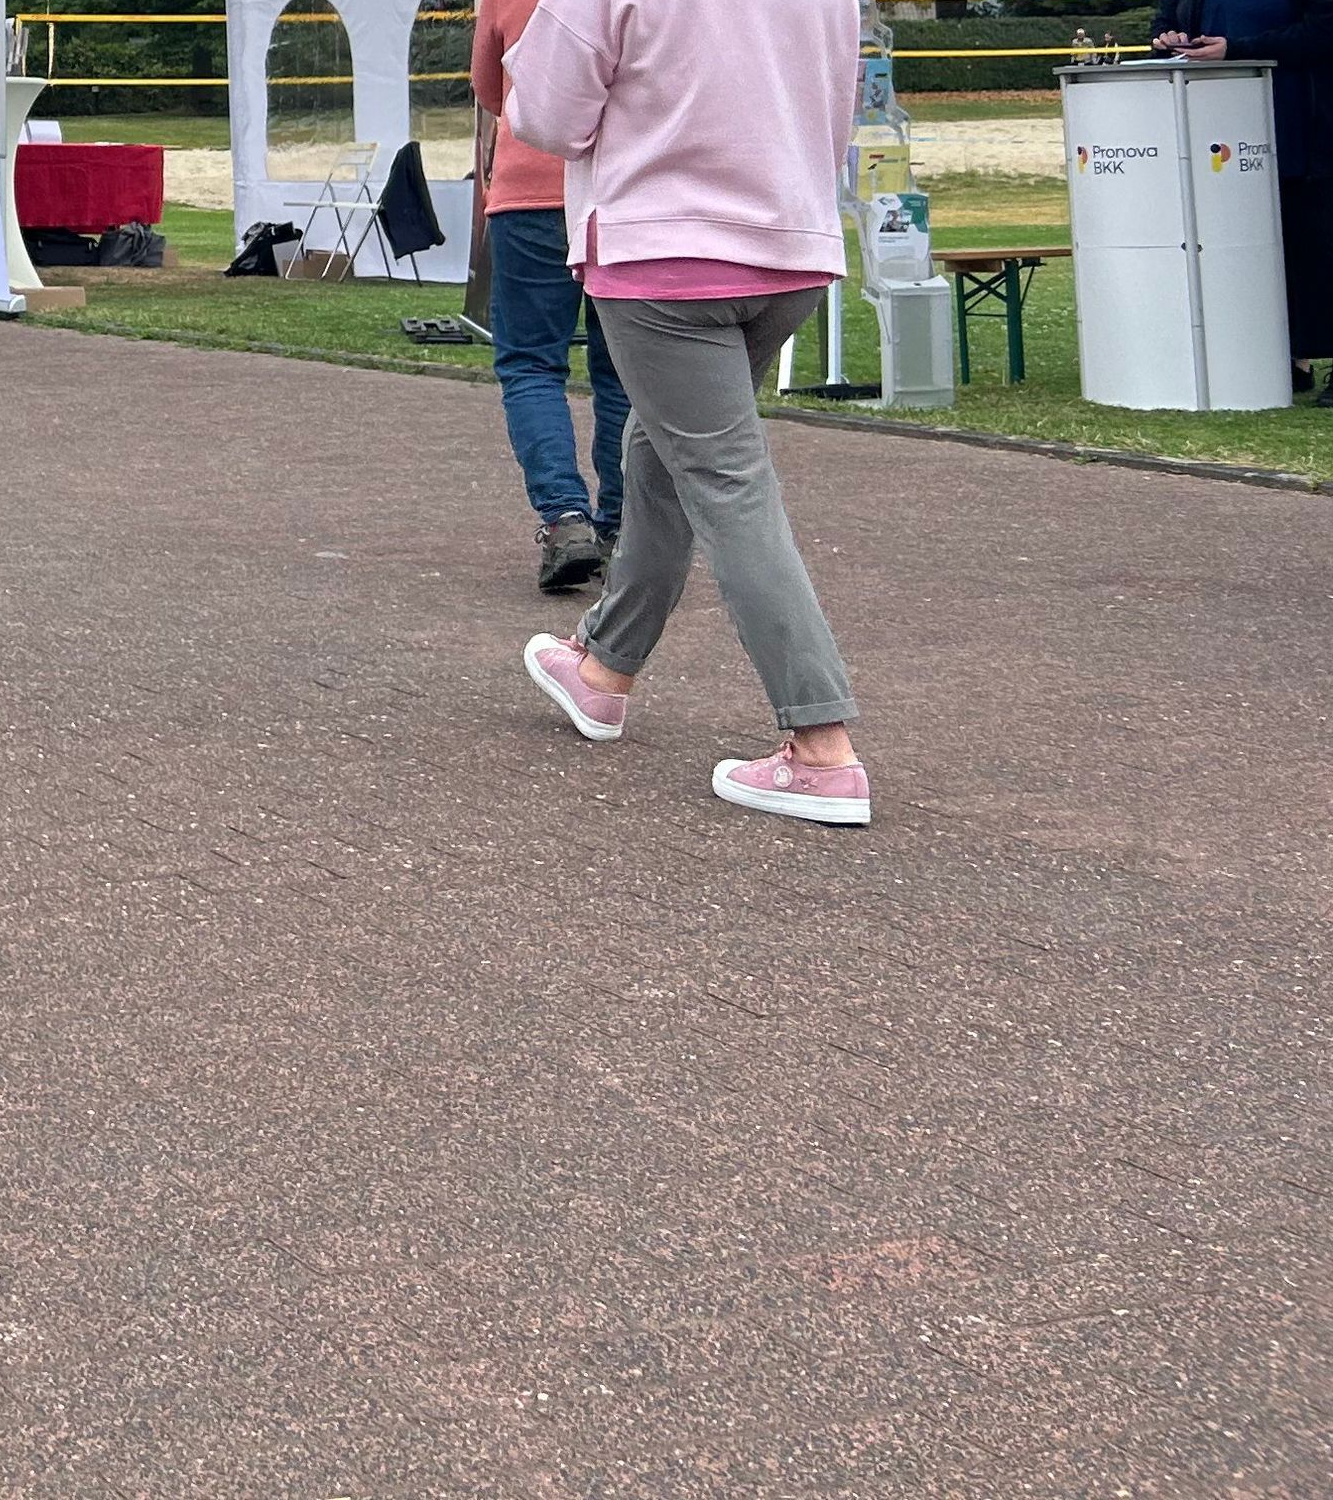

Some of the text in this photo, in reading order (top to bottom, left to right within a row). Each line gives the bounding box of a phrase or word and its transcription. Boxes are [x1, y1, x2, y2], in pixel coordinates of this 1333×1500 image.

[1092, 145, 1158, 159] Pronova
[1094, 161, 1125, 175] BKK
[1239, 158, 1264, 172] BKK
